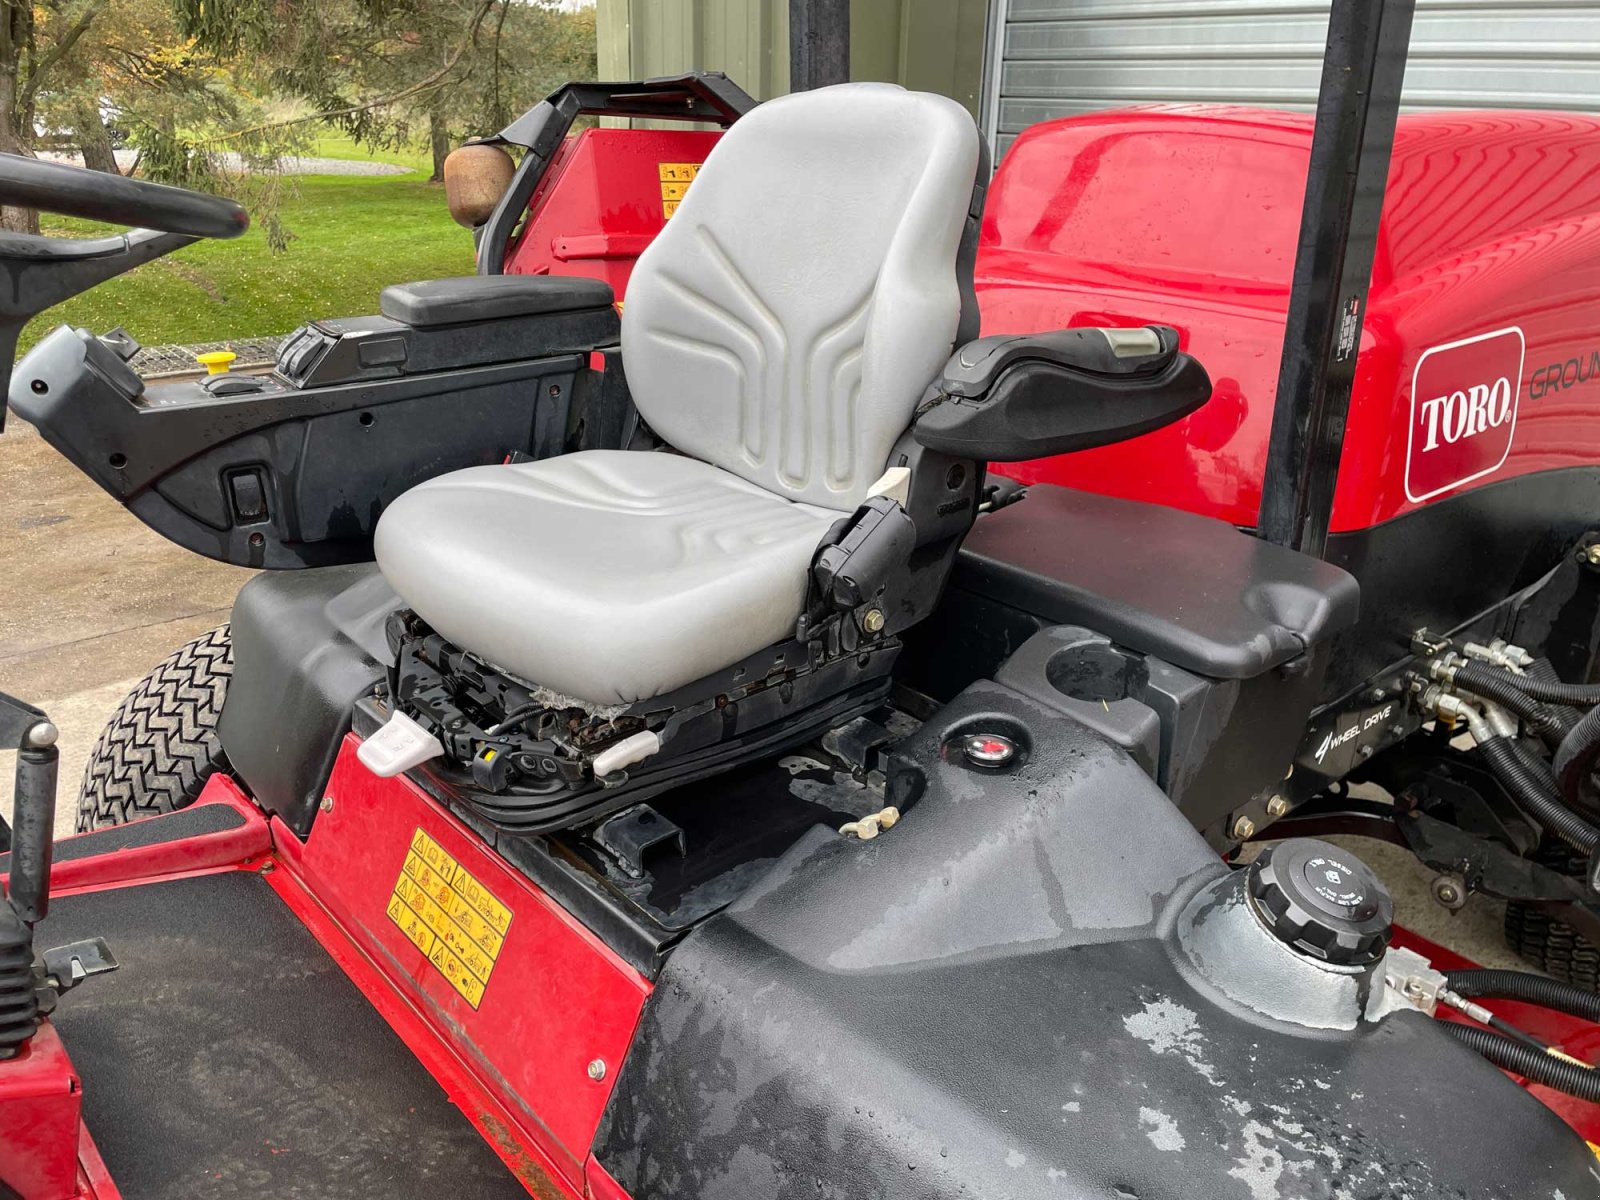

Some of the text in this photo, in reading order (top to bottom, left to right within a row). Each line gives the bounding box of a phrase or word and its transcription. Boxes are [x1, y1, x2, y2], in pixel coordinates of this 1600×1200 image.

[1420, 377, 1511, 452] TORO
[1331, 725, 1360, 749] WHEEL
[1363, 705, 1391, 730] DRIVE
[1327, 859, 1352, 875] DIESEL
